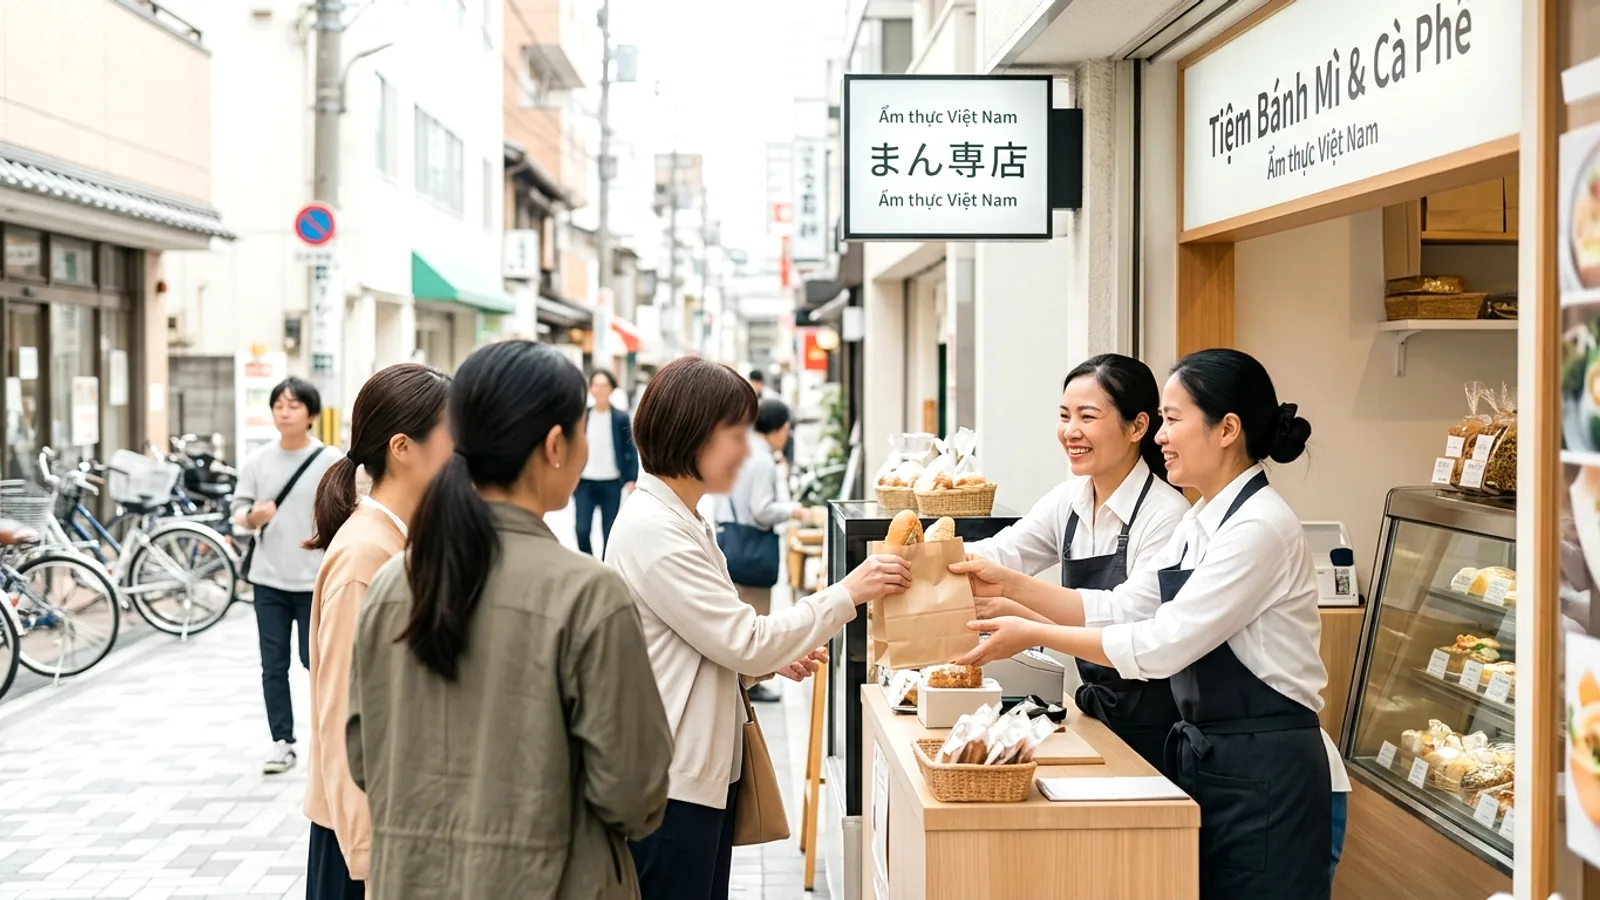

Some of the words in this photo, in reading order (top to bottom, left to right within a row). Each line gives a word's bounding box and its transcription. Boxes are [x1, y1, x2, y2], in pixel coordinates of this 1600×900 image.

[1208, 102, 1252, 165] Tiệm
[1257, 77, 1308, 140] Bánh
[1315, 47, 1340, 115] Mì
[1347, 46, 1366, 101] &
[1373, 17, 1406, 89] Cà
[908, 109, 944, 128] thực
[946, 108, 978, 128] Việt
[982, 110, 1018, 124] Nam
[870, 140, 1028, 179] まん専店
[1287, 141, 1315, 177] thực
[1317, 127, 1344, 166] Việt
[1347, 121, 1379, 153] Nam
[908, 192, 943, 211] thực
[946, 192, 978, 211] Việt
[982, 193, 1018, 208] Nam
